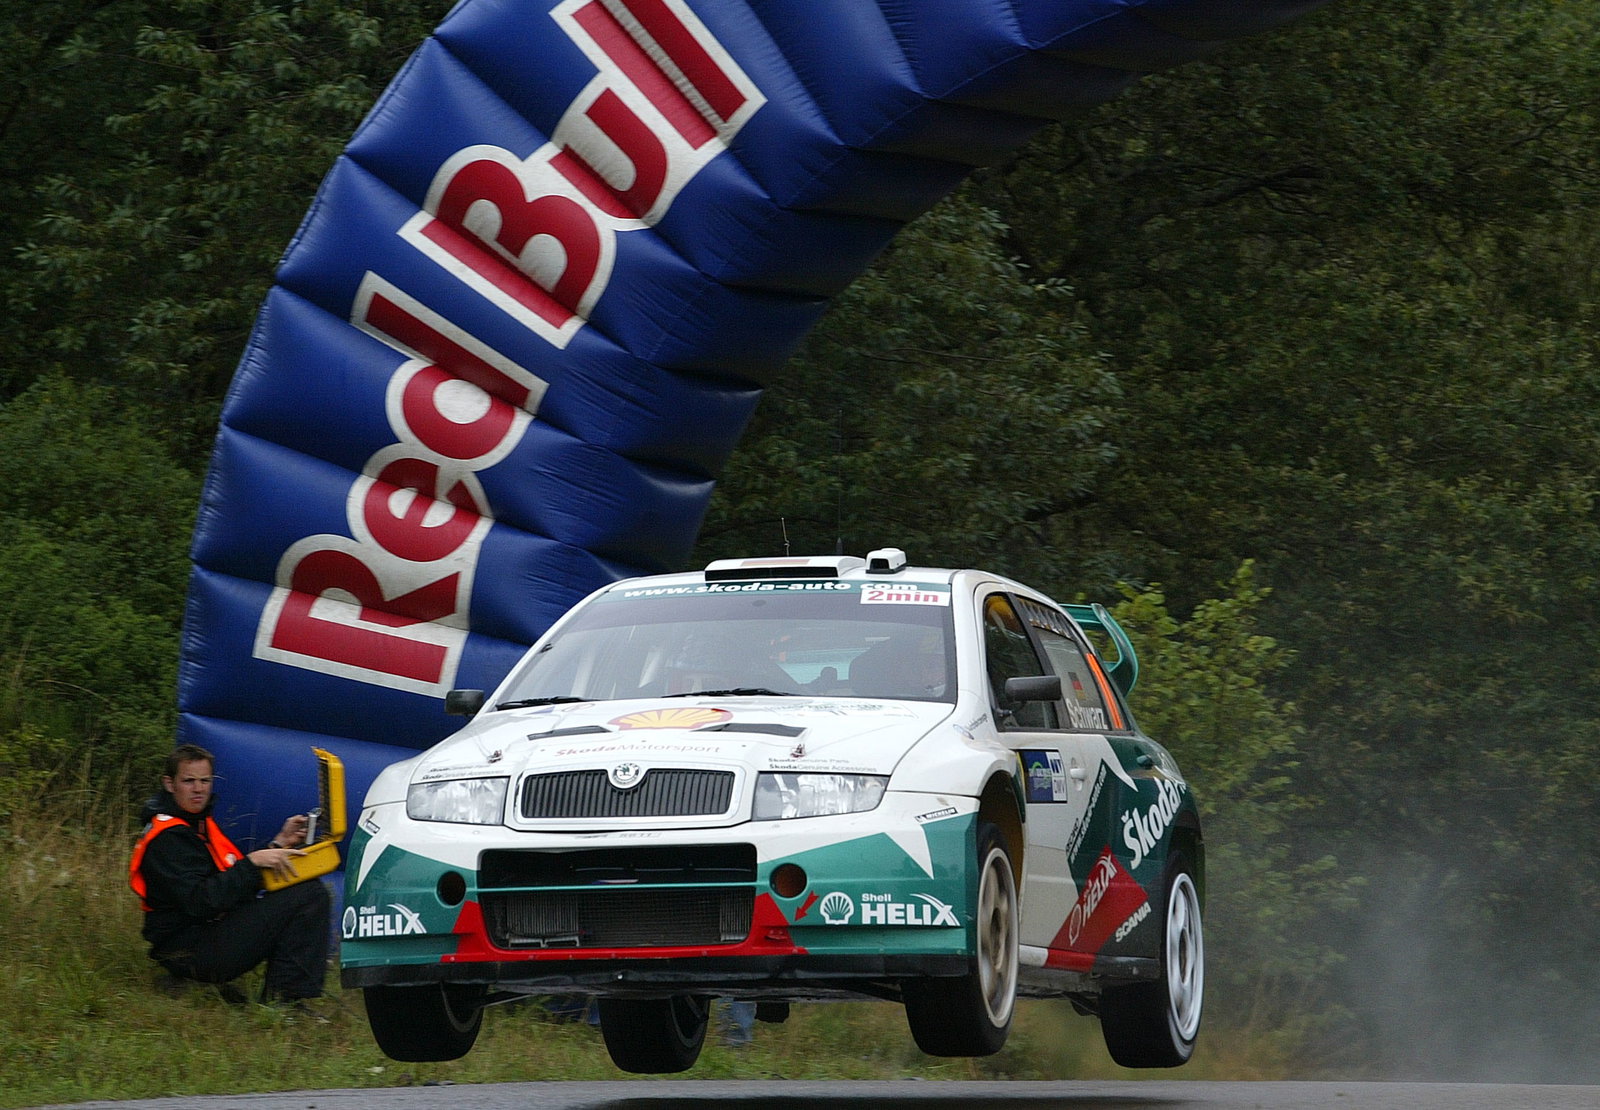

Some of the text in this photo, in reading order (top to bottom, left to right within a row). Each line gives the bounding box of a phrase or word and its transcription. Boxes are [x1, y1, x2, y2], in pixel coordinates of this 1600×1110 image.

[252, 0, 767, 698] Red Bull
[624, 582, 917, 598] www.skoda-autocom
[867, 590, 939, 603] 2min
[1065, 698, 1108, 730] Schwarz
[862, 893, 891, 902] Shell
[1082, 854, 1117, 928] HELIX
[359, 903, 427, 938] HELIX
[360, 906, 376, 915] Shell
[860, 893, 960, 926] HELIX
[1115, 902, 1152, 943] SCANIA
